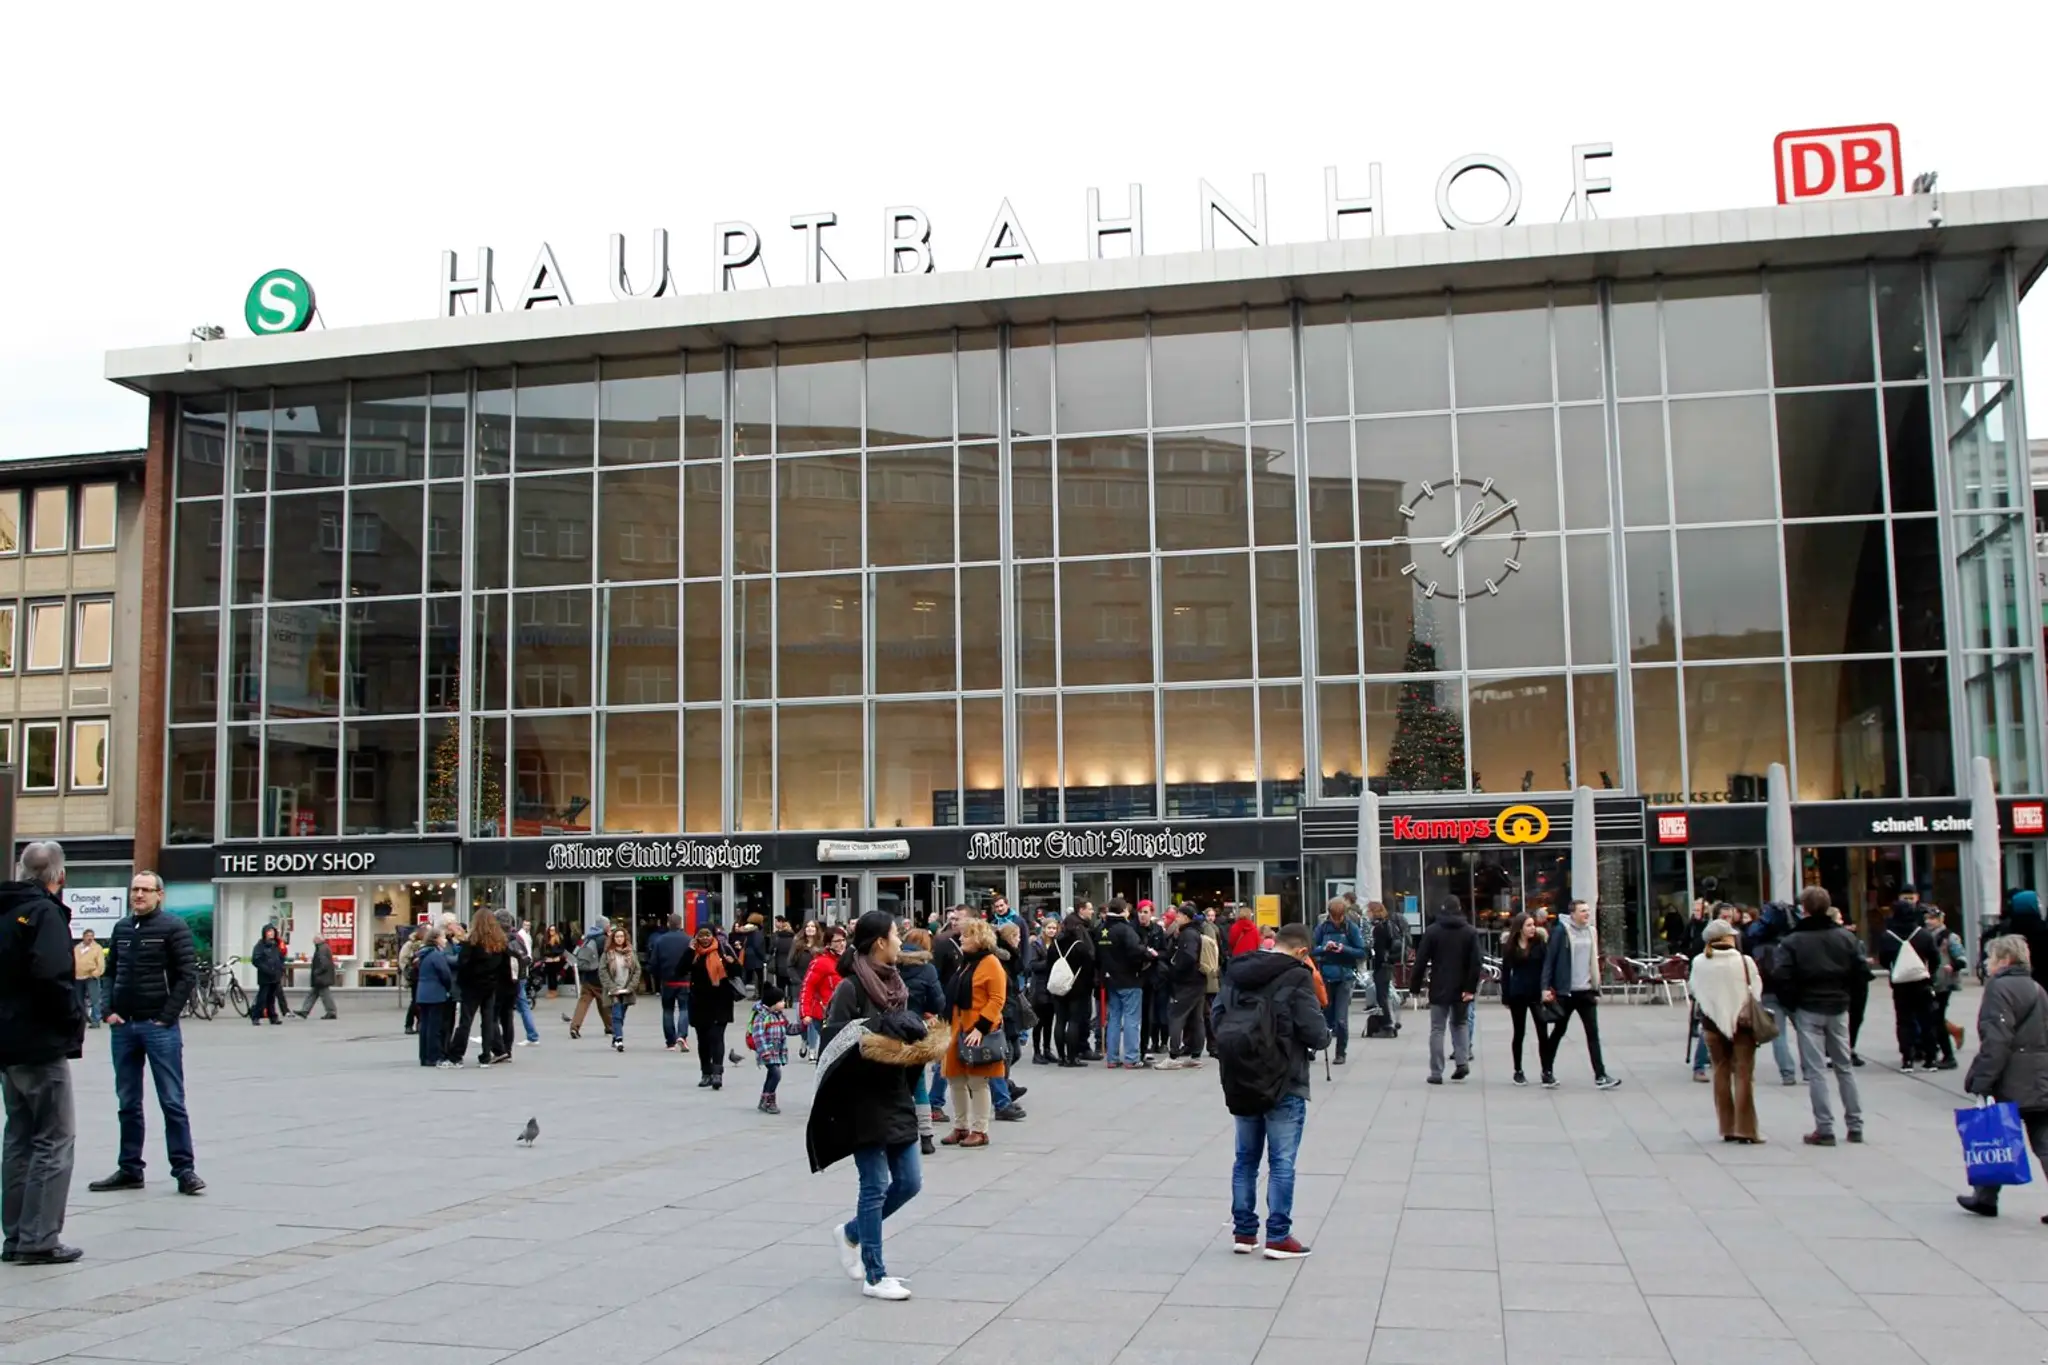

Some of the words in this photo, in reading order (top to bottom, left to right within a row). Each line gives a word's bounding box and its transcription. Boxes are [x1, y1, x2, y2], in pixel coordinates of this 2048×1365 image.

[1790, 137, 1886, 198] DB
[439, 142, 1613, 317] HAUPTBAHNHOF
[258, 277, 297, 331] S
[1392, 815, 1491, 844] Kamps
[1872, 816, 1928, 833] schnell.
[546, 842, 614, 869] Kölner
[967, 832, 1042, 860] Kölner
[220, 855, 257, 872] THE
[264, 854, 318, 872] BODY
[322, 852, 375, 871] SHOP
[71, 893, 101, 905] Change
[79, 904, 109, 914] Cambio
[322, 911, 353, 928] SALE
[1966, 1147, 2013, 1167] JACOBI
